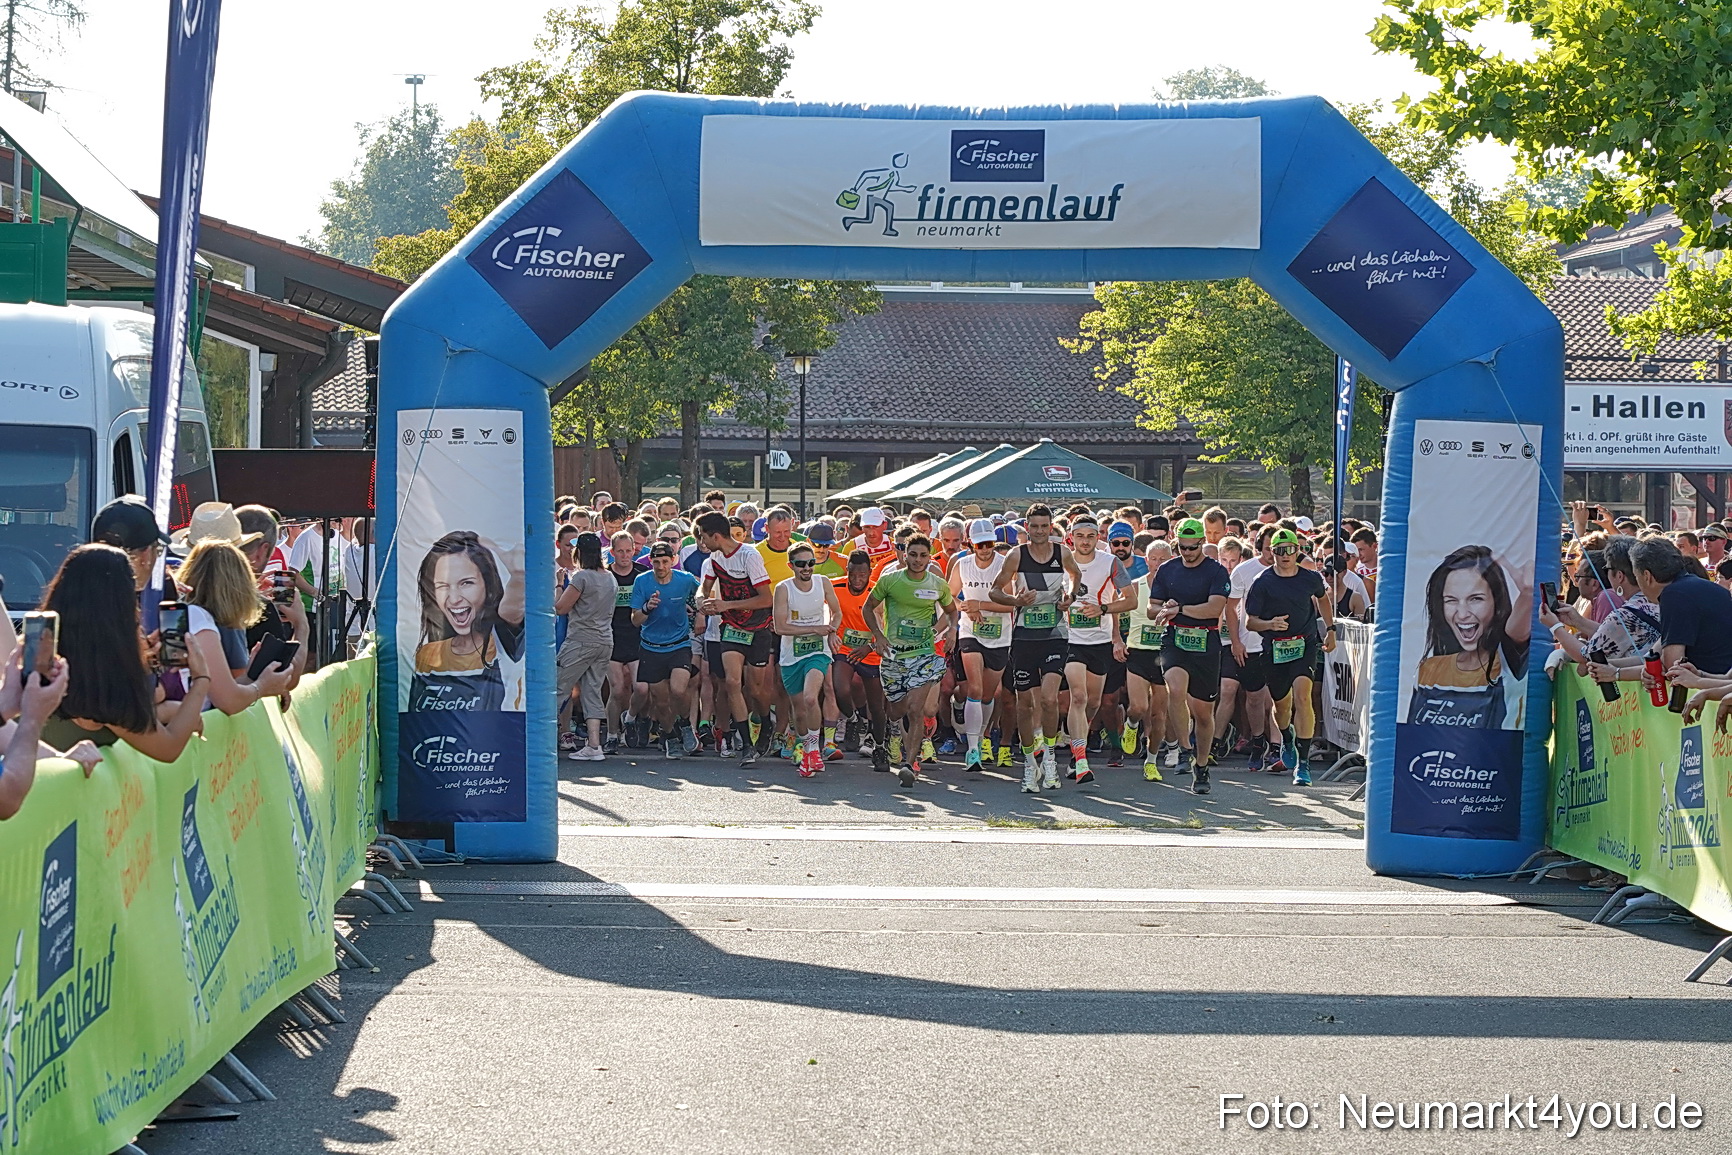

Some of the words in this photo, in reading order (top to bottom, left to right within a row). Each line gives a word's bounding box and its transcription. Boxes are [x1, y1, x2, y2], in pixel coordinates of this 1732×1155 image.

[971, 149, 1039, 163] Fischer
[917, 183, 1125, 221] firmenlauf
[917, 223, 1002, 237] neumarkt
[514, 244, 625, 268] Fischer
[1327, 255, 1356, 273] und
[1360, 251, 1389, 266] das
[523, 267, 615, 280] AUTOMOBILE
[1366, 270, 1409, 290] fährt
[1412, 266, 1447, 279] mit!
[1592, 394, 1706, 419] Hallen
[1579, 432, 1585, 441] i.
[1587, 432, 1597, 441] d.
[1600, 431, 1622, 441] OPf.
[1625, 431, 1653, 443] grüßt
[1655, 432, 1675, 442] ihre
[1677, 432, 1707, 442] Gäste
[1564, 444, 1592, 453] einen
[1595, 445, 1661, 456] angenehmen
[1663, 445, 1721, 455] Aufenthalt!
[771, 451, 785, 467] WC
[1032, 613, 1049, 621] 196
[910, 627, 916, 635] 3
[979, 623, 995, 632] 227
[731, 630, 746, 638] 119
[848, 635, 868, 644] 1377
[1180, 634, 1202, 645] 1093
[1279, 646, 1300, 656] 1092
[426, 748, 500, 764] Fischer
[1423, 763, 1498, 781] Fischer
[462, 777, 478, 787] das
[1429, 780, 1491, 790] AUTOMOBILE
[1459, 794, 1474, 804] das
[20, 923, 117, 1090] firmenlauf
